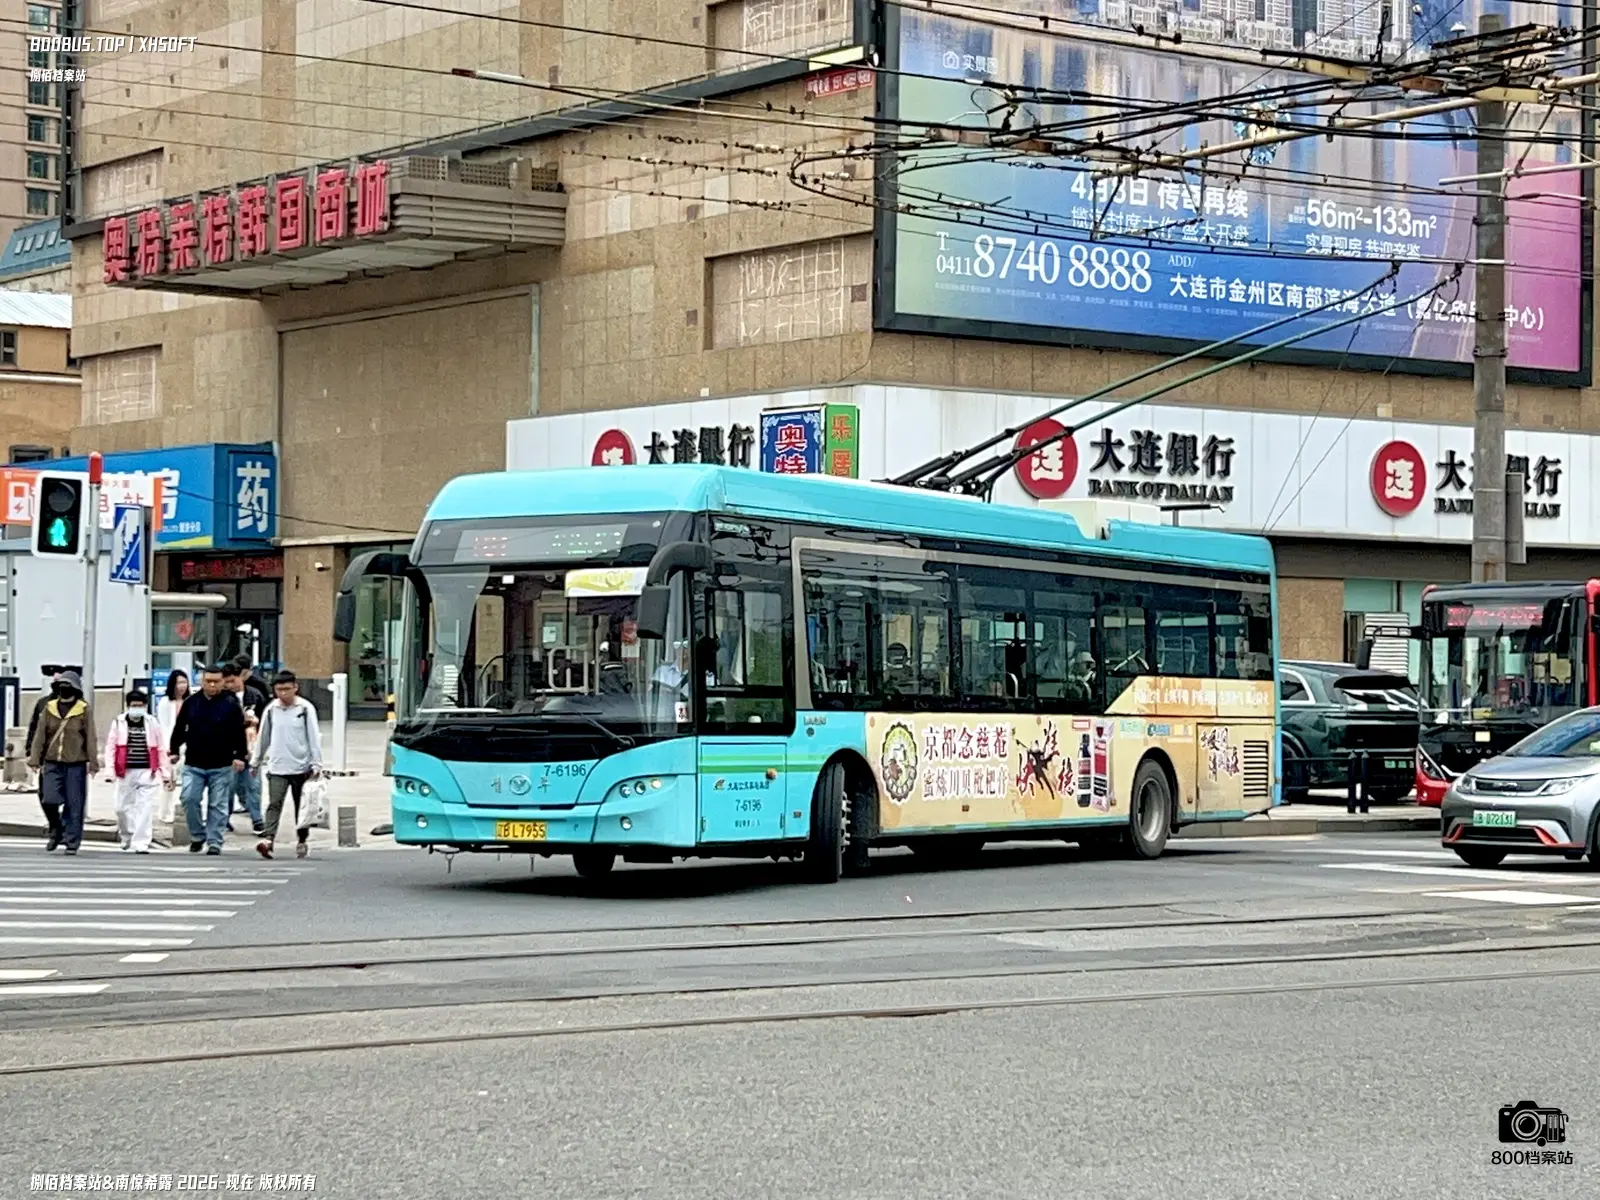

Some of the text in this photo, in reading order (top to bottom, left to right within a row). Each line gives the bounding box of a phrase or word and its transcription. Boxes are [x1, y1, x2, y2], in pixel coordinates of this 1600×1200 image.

[936, 234, 1152, 293] 0411 8740 8888
[1089, 427, 1236, 480] 大连银行
[1435, 450, 1563, 496] 大行
[237, 461, 271, 533] 药
[544, 764, 586, 777] 7-6196
